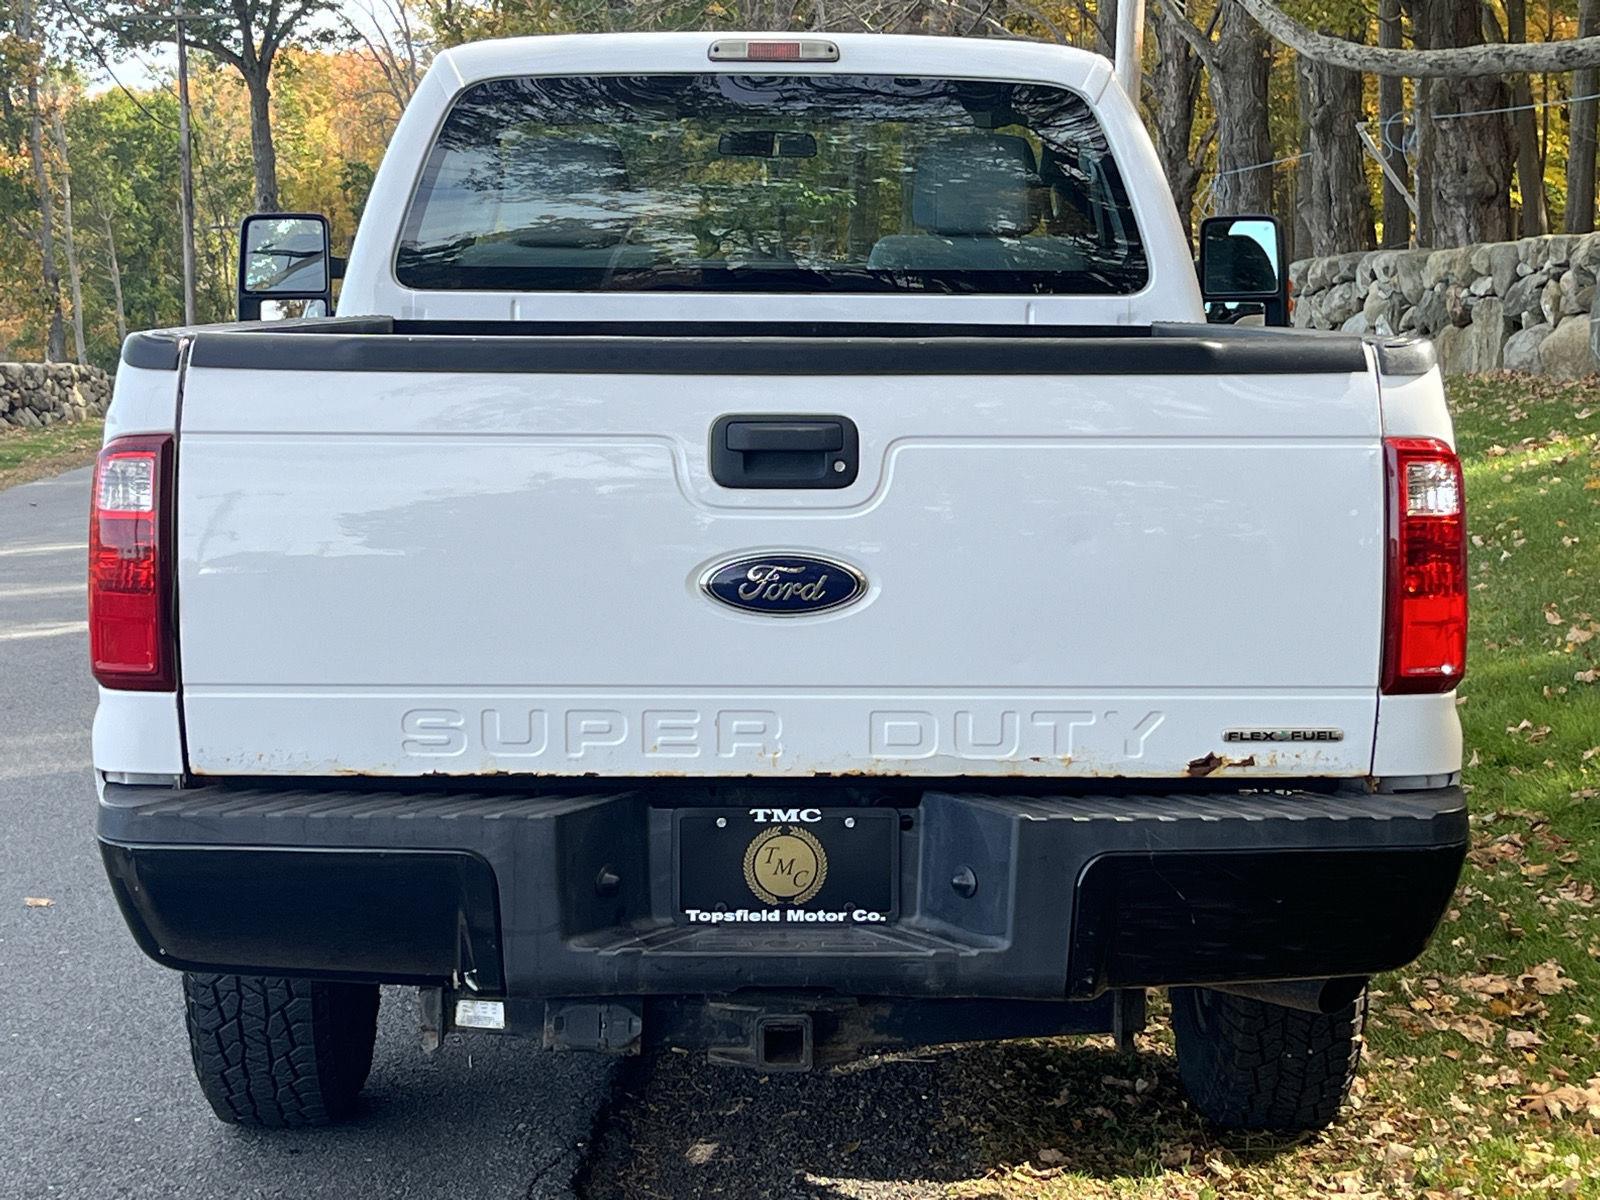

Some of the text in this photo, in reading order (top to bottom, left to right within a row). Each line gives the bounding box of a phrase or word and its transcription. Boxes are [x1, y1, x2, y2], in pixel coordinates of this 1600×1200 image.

[738, 564, 829, 601] Ford
[401, 709, 1165, 760] SUPER DUTY
[1228, 731, 1339, 741] FLEX FUEL
[750, 808, 822, 823] TMC
[765, 847, 809, 888] TMC
[685, 909, 886, 923] Topsfield Motor Co.
